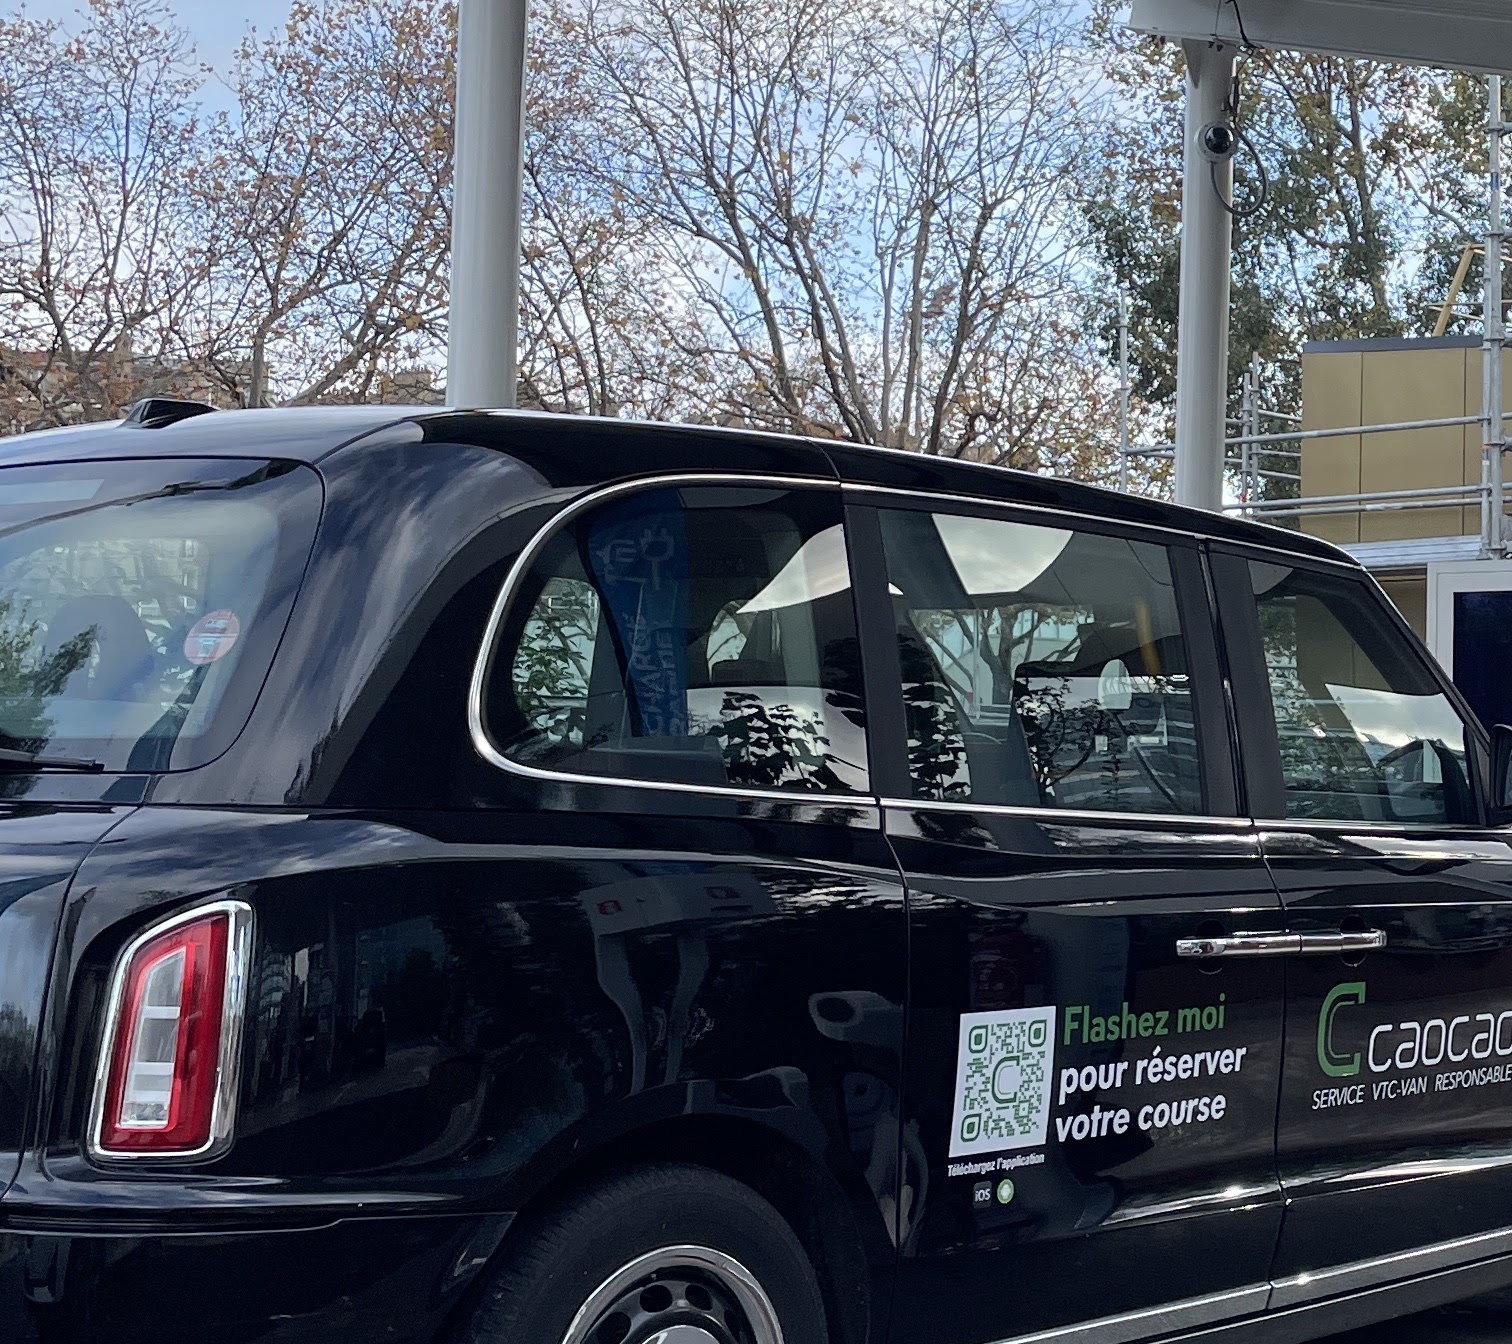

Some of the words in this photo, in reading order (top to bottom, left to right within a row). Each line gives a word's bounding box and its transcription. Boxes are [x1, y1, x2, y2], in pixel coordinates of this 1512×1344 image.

[1063, 1001, 1169, 1045] Flashez
[1177, 992, 1226, 1033] moi
[1058, 1061, 1129, 1105] pour
[1135, 1045, 1247, 1085] réserver
[1312, 1084, 1366, 1110] SERVICE
[1372, 1076, 1428, 1101] VTC-VAN
[1055, 1105, 1131, 1143] votre
[1138, 1094, 1227, 1131] course
[947, 1161, 996, 1177] Téléchargez
[996, 1153, 1045, 1171] l'application
[974, 1188, 991, 1202] iOS
